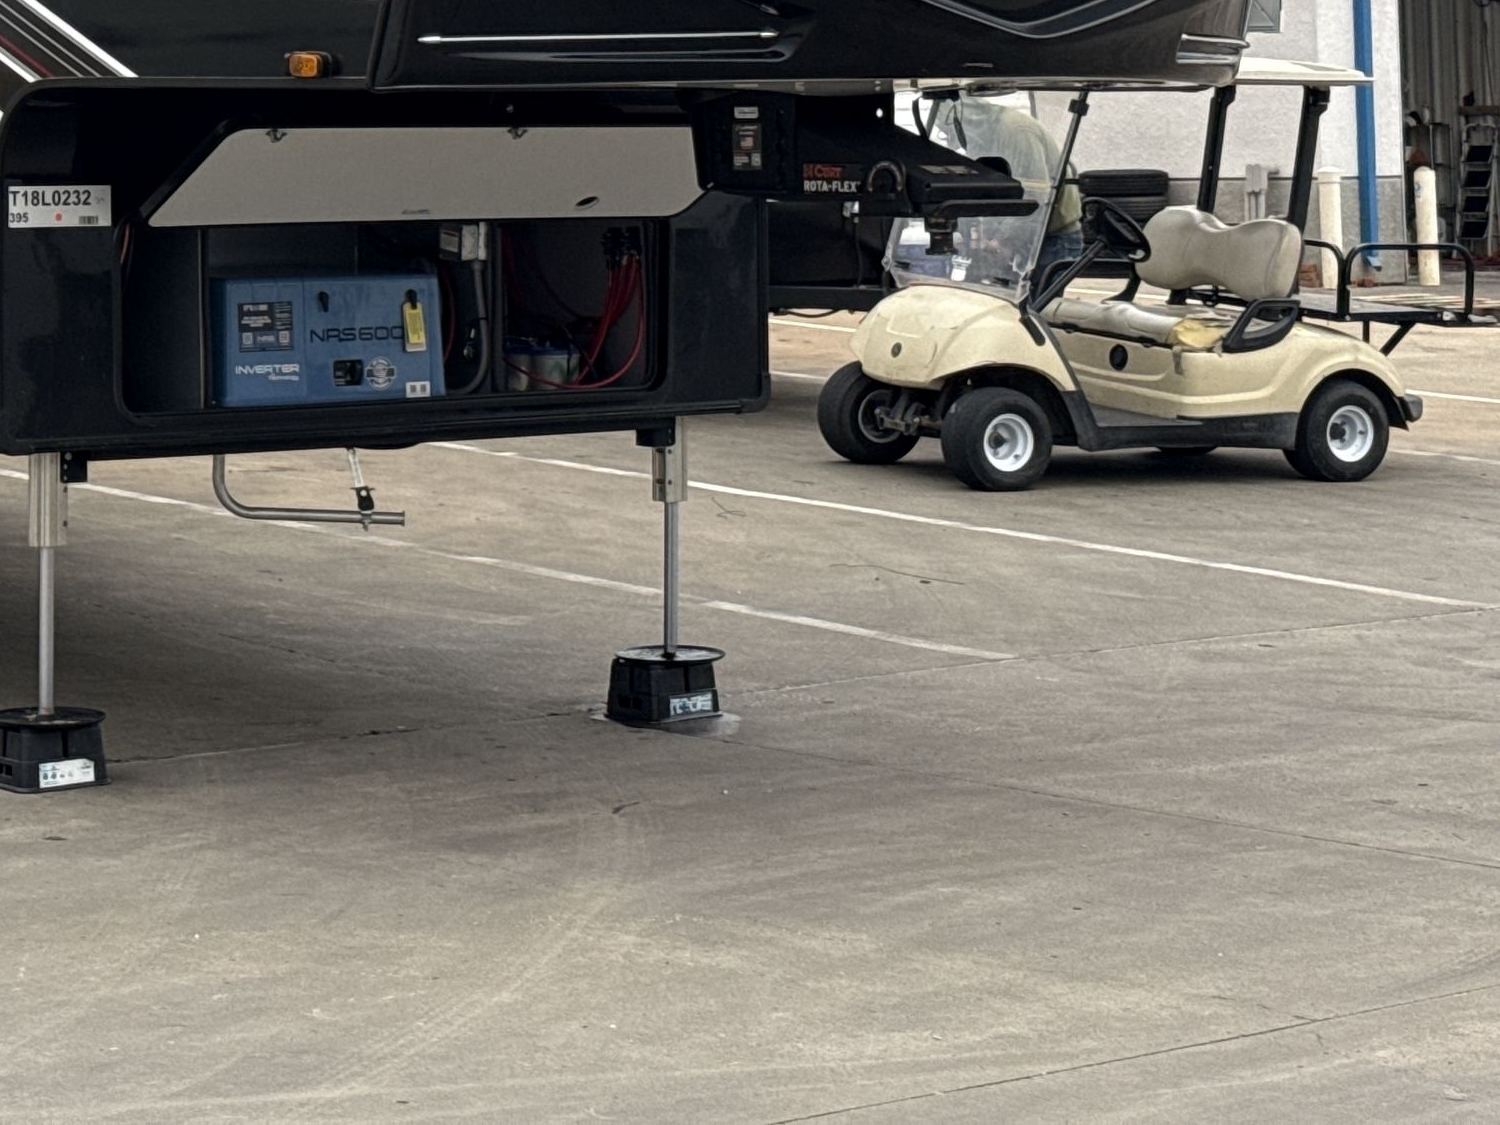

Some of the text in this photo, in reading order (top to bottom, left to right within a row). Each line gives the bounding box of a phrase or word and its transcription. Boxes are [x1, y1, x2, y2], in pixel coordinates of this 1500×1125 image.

[9, 189, 92, 207] T18L0232
[9, 212, 29, 223] 395
[235, 363, 300, 375] INVERTER
